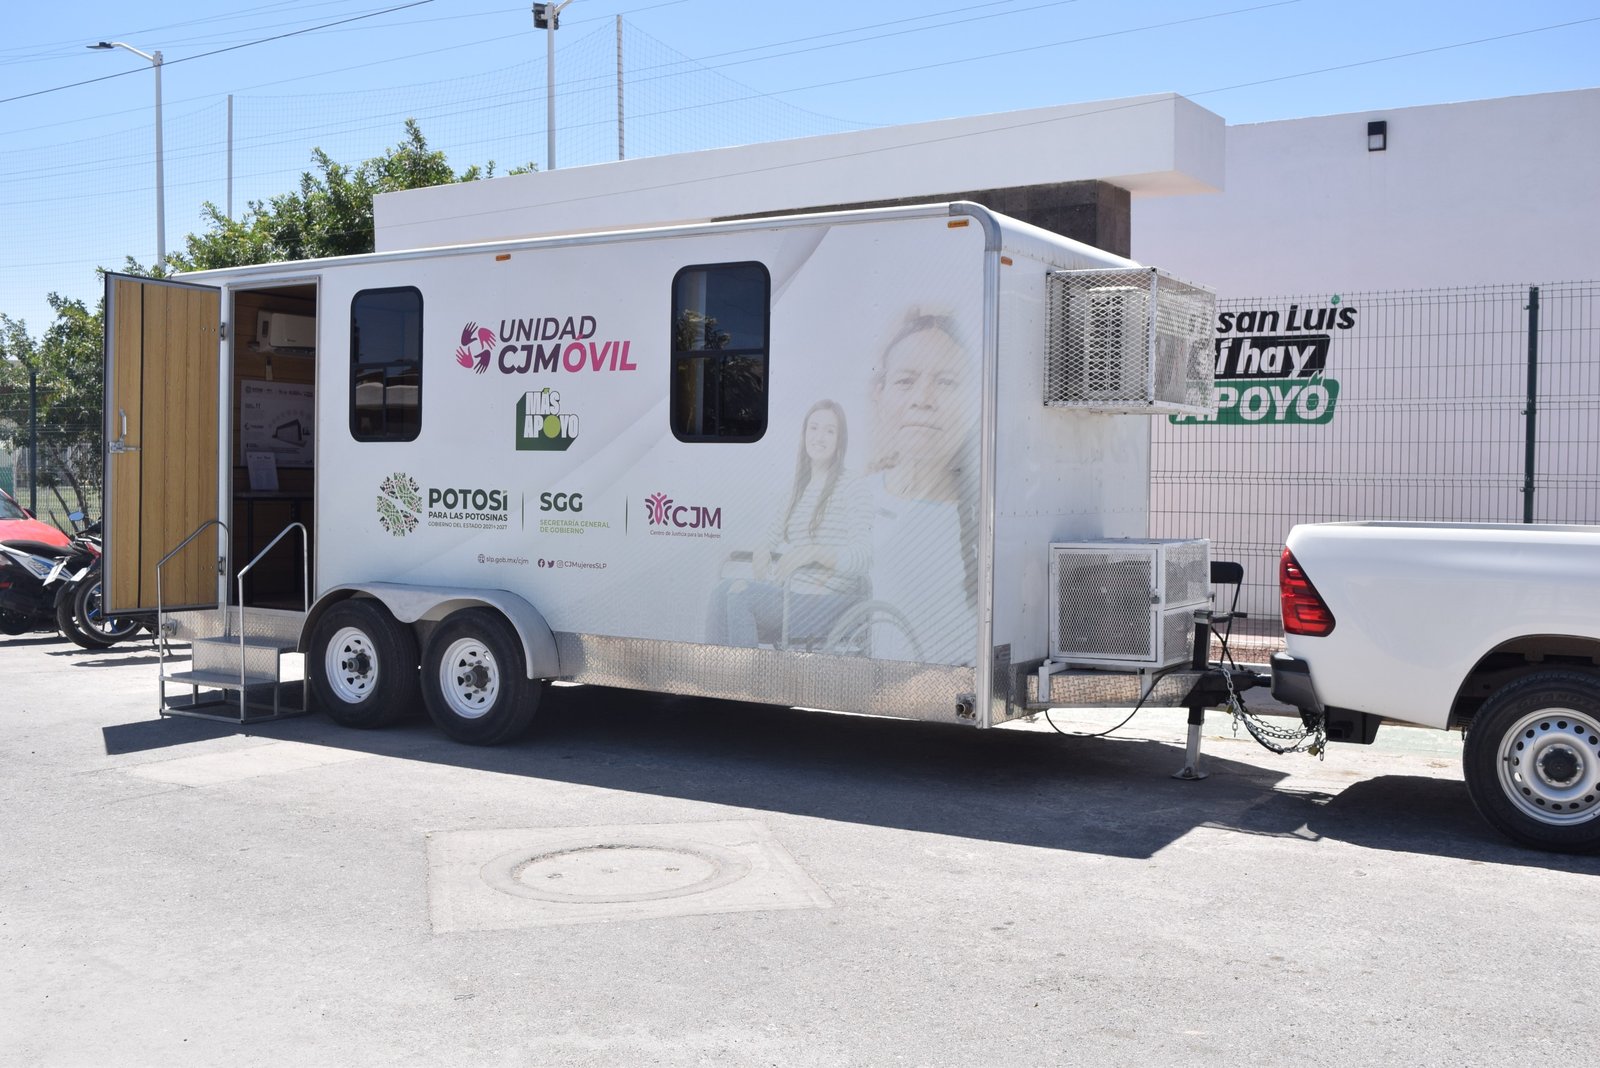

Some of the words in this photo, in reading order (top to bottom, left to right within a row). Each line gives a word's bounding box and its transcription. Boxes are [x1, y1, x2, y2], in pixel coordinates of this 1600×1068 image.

[1215, 309, 1280, 334] san
[1285, 294, 1358, 332] Luis
[499, 315, 597, 343] UNIDAD
[498, 333, 638, 375] CJMÓVIL
[1235, 338, 1317, 379] hay
[525, 387, 561, 416] MÁS
[523, 414, 580, 439] APOYO
[539, 491, 583, 513] SGG
[428, 511, 448, 520] PARA
[449, 511, 464, 520] LAS
[465, 512, 508, 522] POTOSINAS
[463, 522, 483, 530] ESTADO
[539, 519, 580, 528] SECRETARÍA
[580, 520, 611, 529] GENERAL
[672, 505, 722, 529] CJM
[549, 527, 585, 535] GOBIERNO
[564, 560, 608, 571] CJMujeresSLP
